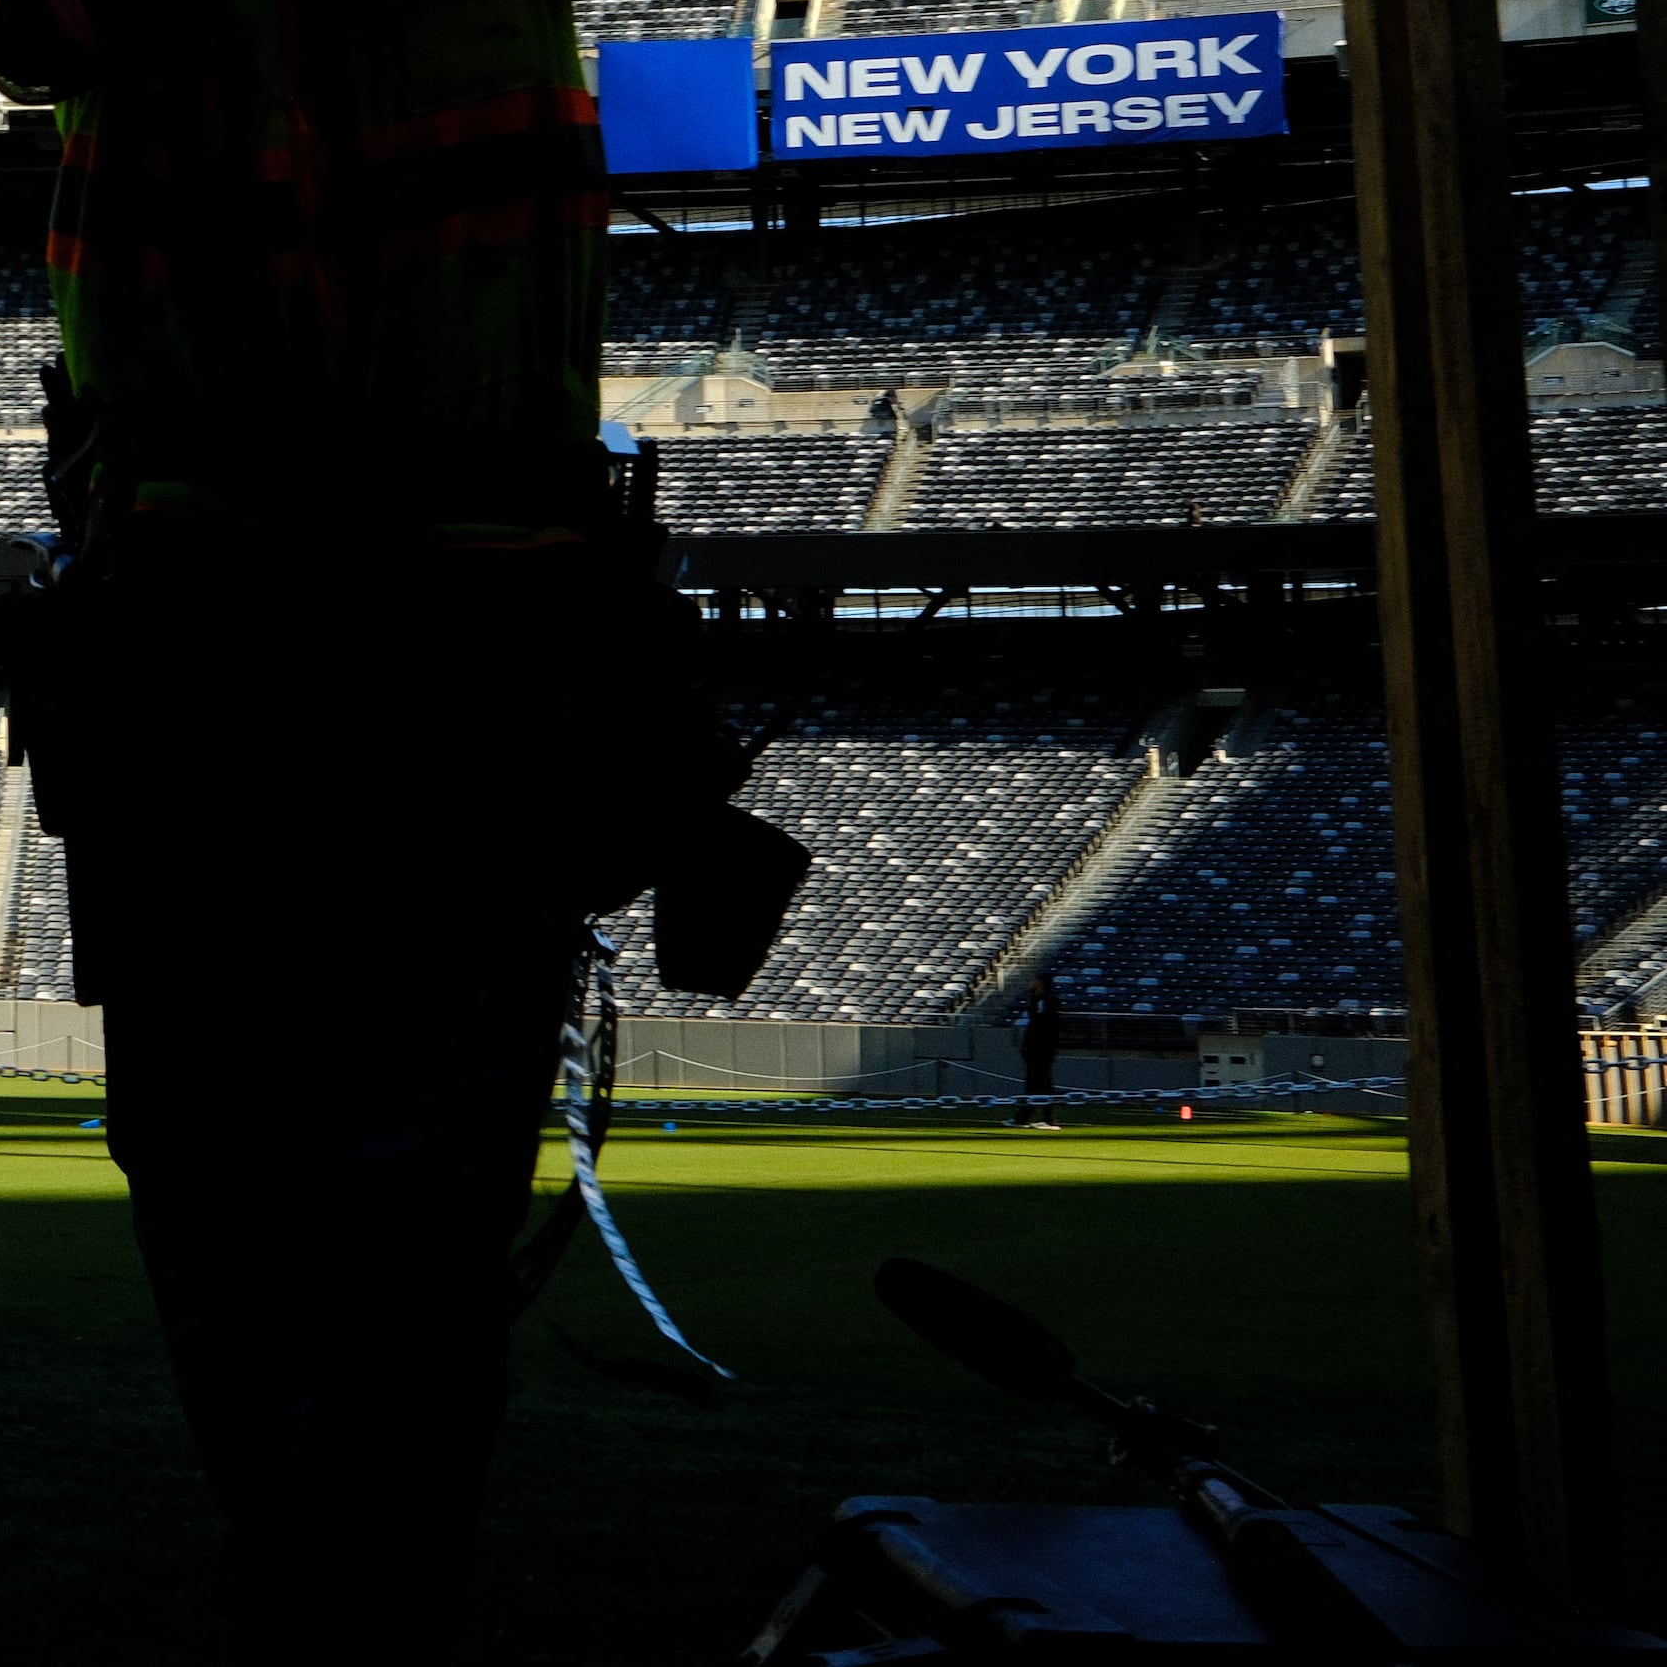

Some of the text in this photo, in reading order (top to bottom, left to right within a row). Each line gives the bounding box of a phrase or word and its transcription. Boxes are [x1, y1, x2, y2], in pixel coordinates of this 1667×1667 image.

[784, 34, 1263, 101] NEW YORK
[785, 89, 1264, 148] NEW JERSEY
